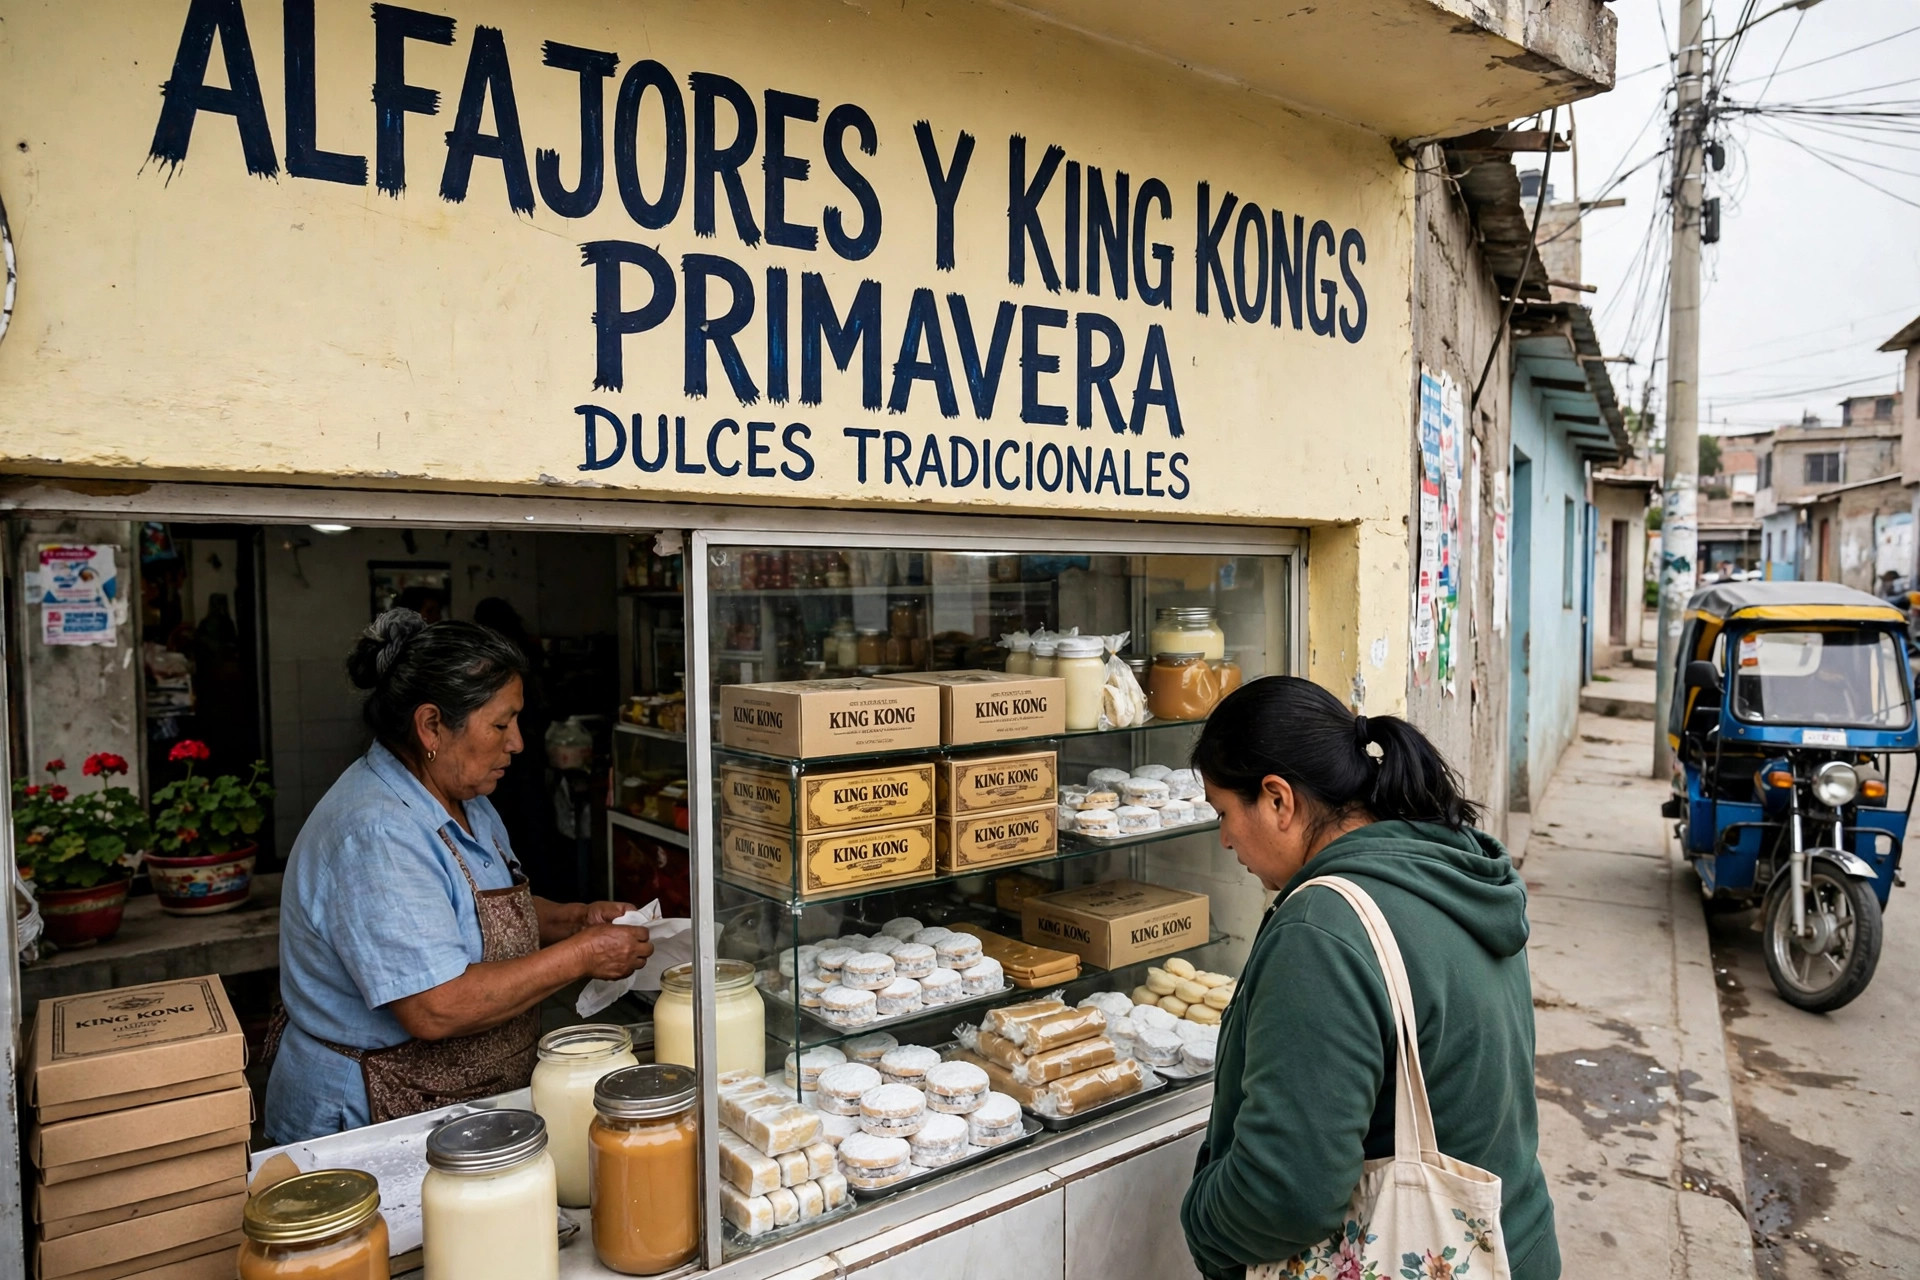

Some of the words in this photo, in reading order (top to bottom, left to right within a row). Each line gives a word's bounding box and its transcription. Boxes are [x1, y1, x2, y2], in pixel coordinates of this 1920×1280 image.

[139, 0, 882, 262] ALFAJORES
[913, 120, 975, 272] Y
[1008, 132, 1175, 311] KING
[1195, 179, 1368, 344] KONGS
[576, 240, 1184, 439] PRIMAVERA
[574, 404, 815, 482] DULCES
[843, 427, 1190, 500] TRADICIONALES
[733, 706, 755, 724] KING
[757, 709, 783, 729] KONG
[829, 710, 869, 729] KING
[874, 706, 916, 726] KONG
[975, 700, 1009, 719] KING
[1012, 696, 1048, 715] KONG
[974, 772, 1004, 789] KING
[1007, 768, 1038, 785] KONG
[733, 781, 754, 799] KING
[756, 786, 781, 805] KONG
[833, 786, 868, 805] KING
[872, 781, 909, 801] KONG
[974, 825, 1005, 843] KING
[1008, 819, 1039, 838] KONG
[833, 845, 868, 864] KING
[872, 838, 909, 858] KONG
[1130, 924, 1159, 944] KING
[1162, 915, 1192, 936] KONG
[75, 1013, 129, 1029] KING
[137, 1003, 195, 1019] KONG
